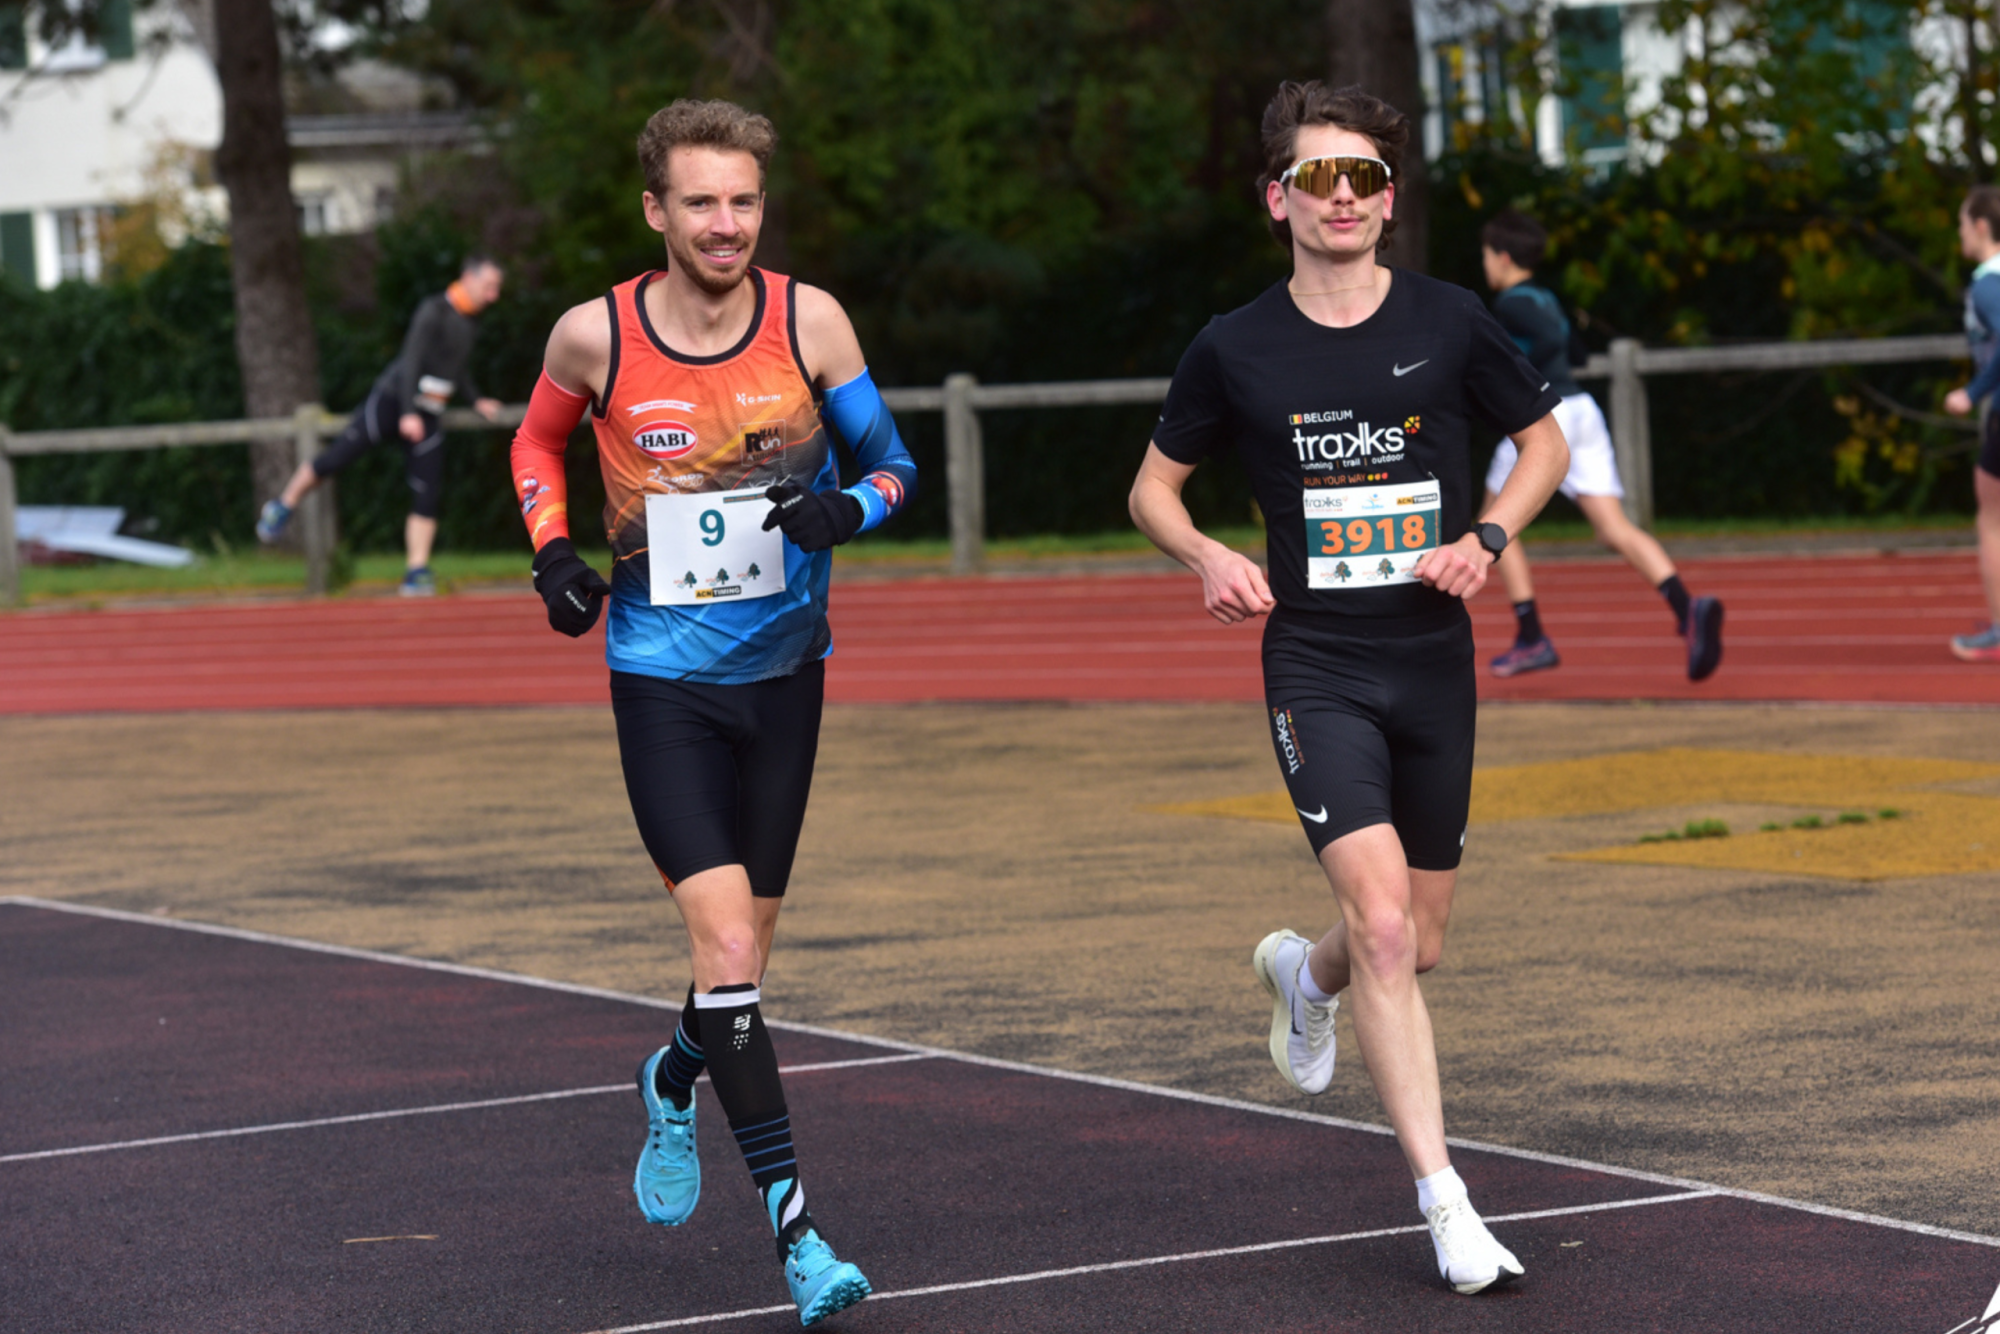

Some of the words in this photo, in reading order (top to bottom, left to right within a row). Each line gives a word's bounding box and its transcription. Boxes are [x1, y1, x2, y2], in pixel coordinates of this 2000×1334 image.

[1303, 410, 1353, 424] BELGIUM
[641, 432, 688, 448] HABI
[745, 432, 781, 453] Run
[1292, 421, 1405, 461] trakks
[1301, 461, 1333, 471] running
[1342, 458, 1361, 468] trail
[1371, 453, 1405, 465] outdoor
[1304, 477, 1321, 487] RUN
[1322, 475, 1347, 486] YOUR
[1347, 473, 1366, 484] WAY
[699, 509, 726, 547] 9
[1320, 514, 1427, 555] 3918
